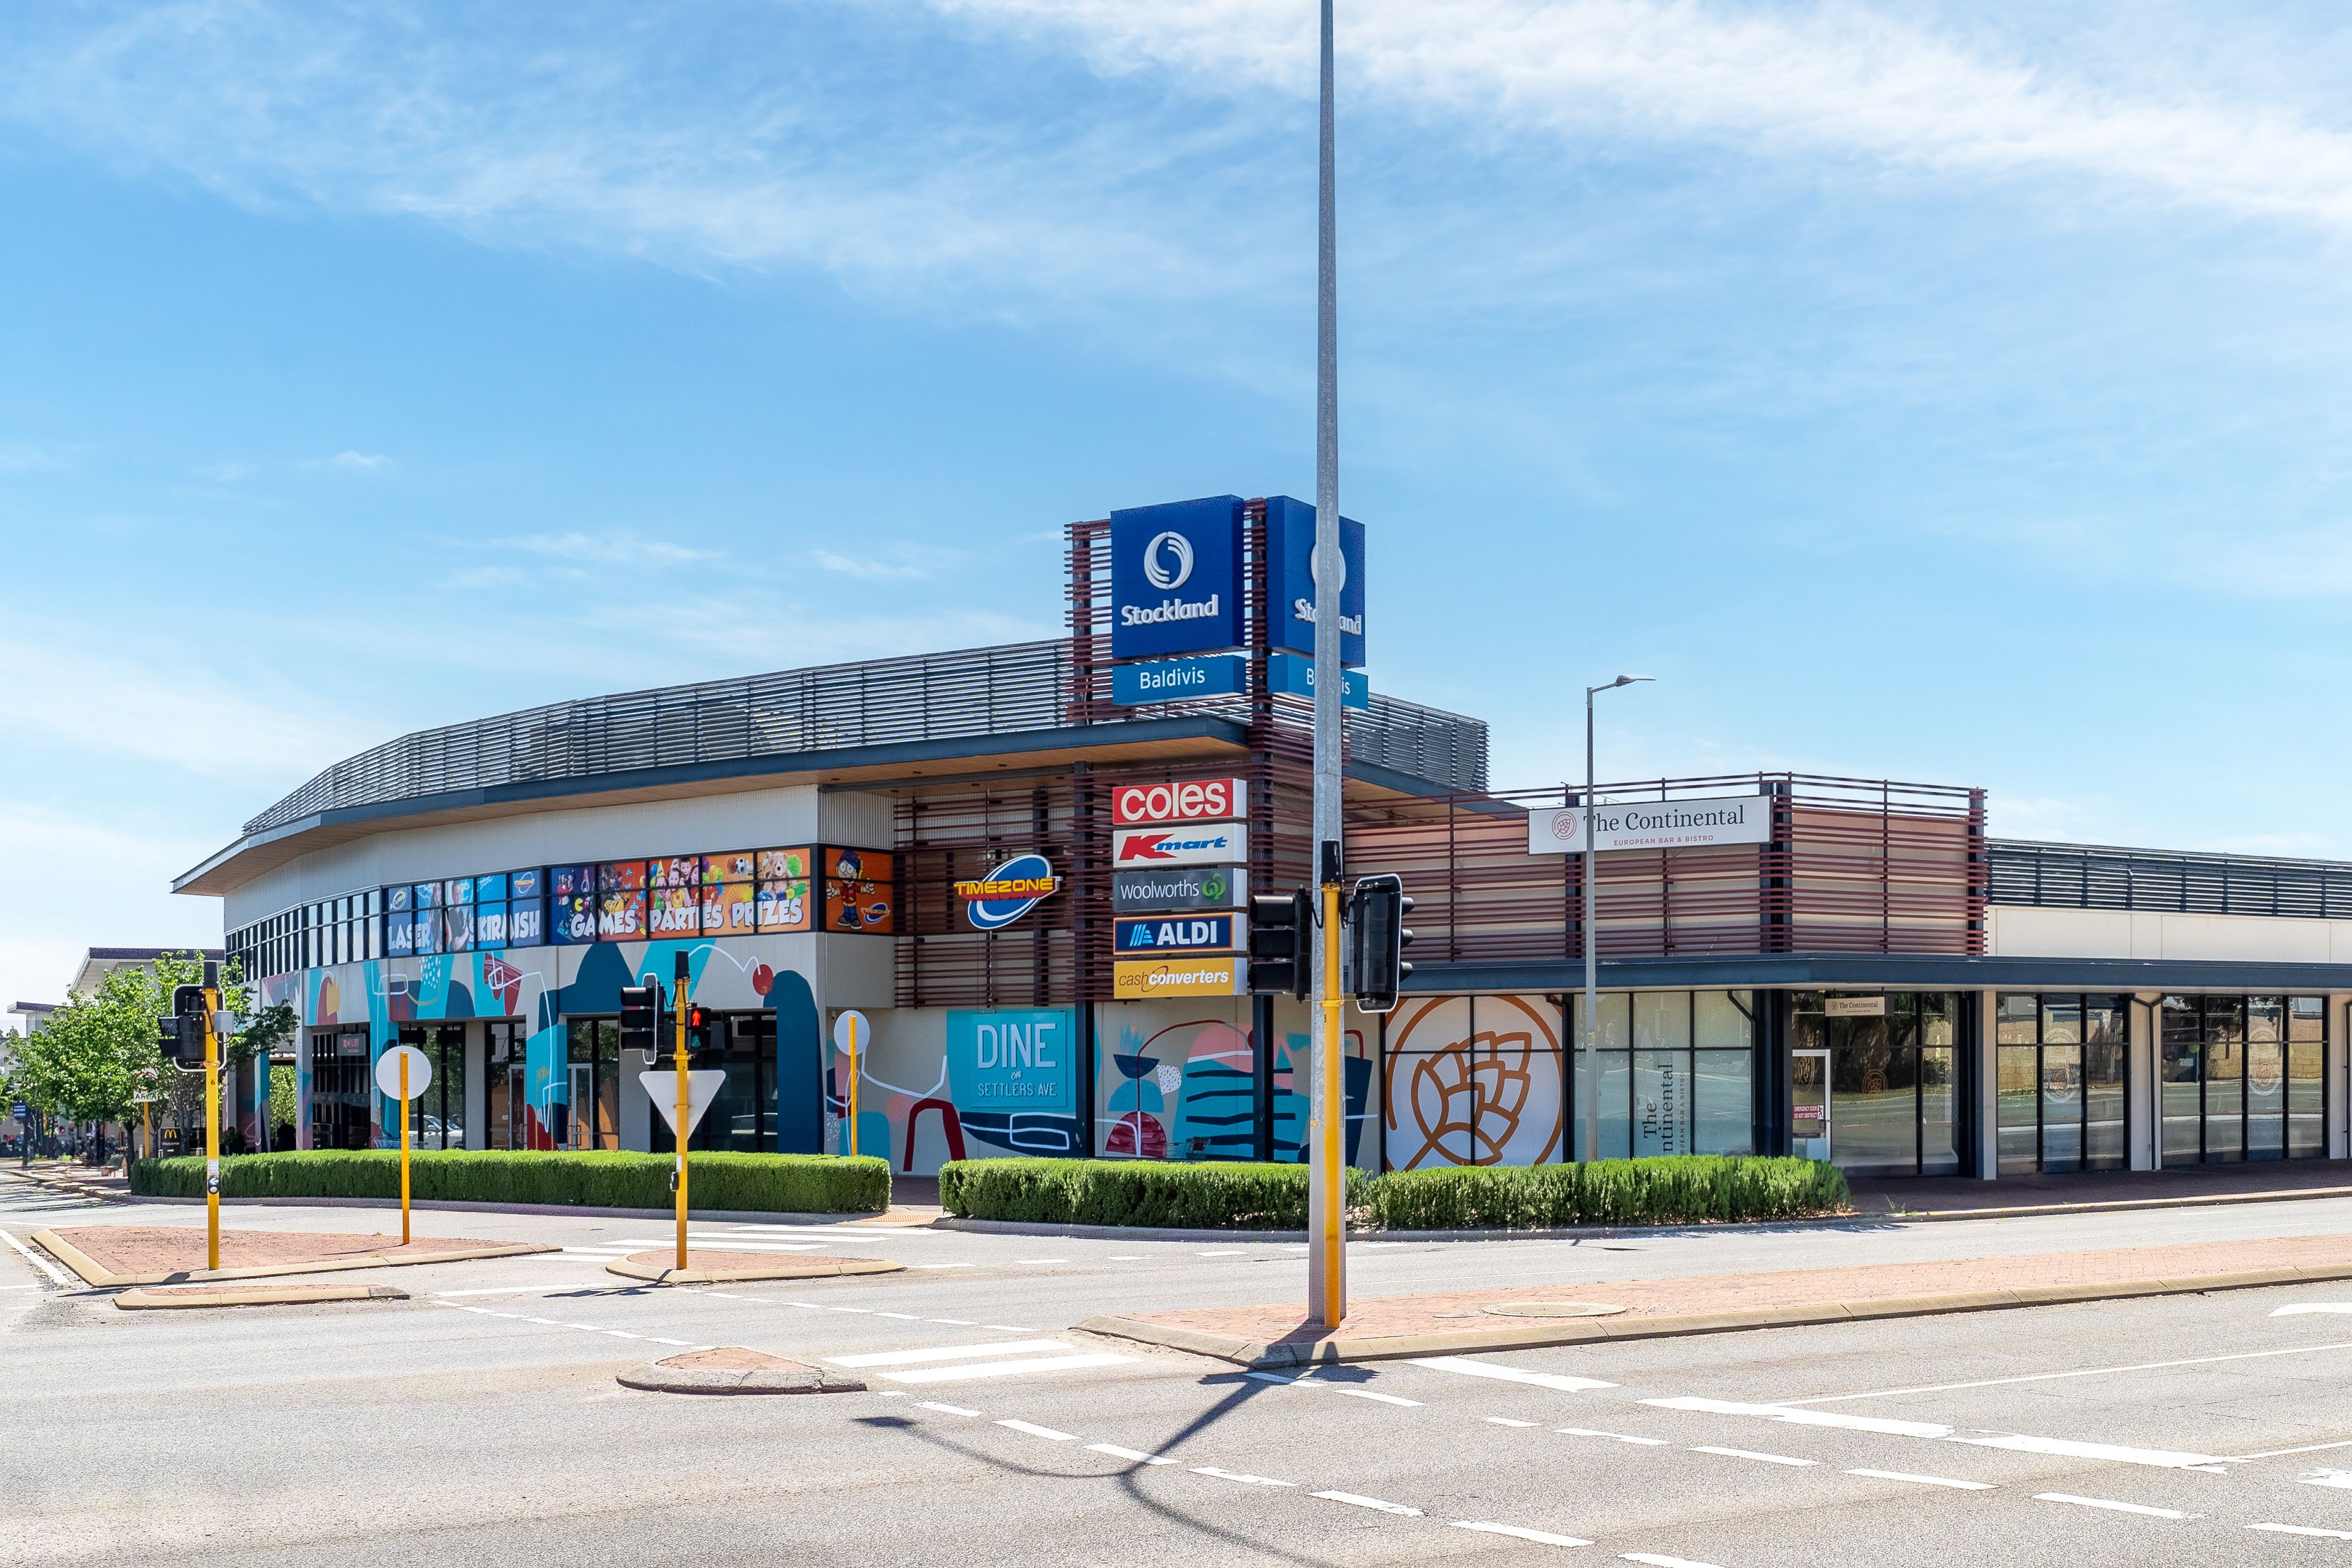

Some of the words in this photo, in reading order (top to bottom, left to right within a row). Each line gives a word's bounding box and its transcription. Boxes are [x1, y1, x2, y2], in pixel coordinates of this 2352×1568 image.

[1121, 594, 1218, 626] Stockland
[1295, 598, 1361, 635] Stand
[1140, 667, 1205, 689] Baldivis
[1121, 782, 1226, 821] coles
[1625, 805, 1744, 830] Continental
[1119, 834, 1228, 861] Kmart
[1614, 838, 1656, 846] EUROPEAN
[954, 878, 1053, 895] TIMEZONE
[1121, 879, 1199, 899] Woolworths
[387, 922, 432, 950] LASER
[469, 909, 540, 944] SKIRMISH
[571, 910, 637, 938] GAMES
[650, 906, 724, 933] PARTIES
[732, 899, 803, 927] PRIZES
[1157, 921, 1217, 946] ALDI
[1849, 1000, 1879, 1008] Continental
[978, 1023, 1057, 1069] DINE
[1011, 1071, 1022, 1080] on
[978, 1084, 1034, 1096] SETTLERS
[1037, 1084, 1057, 1096] AVE
[1642, 1102, 1657, 1138] The
[1657, 1063, 1673, 1152] ntinental
